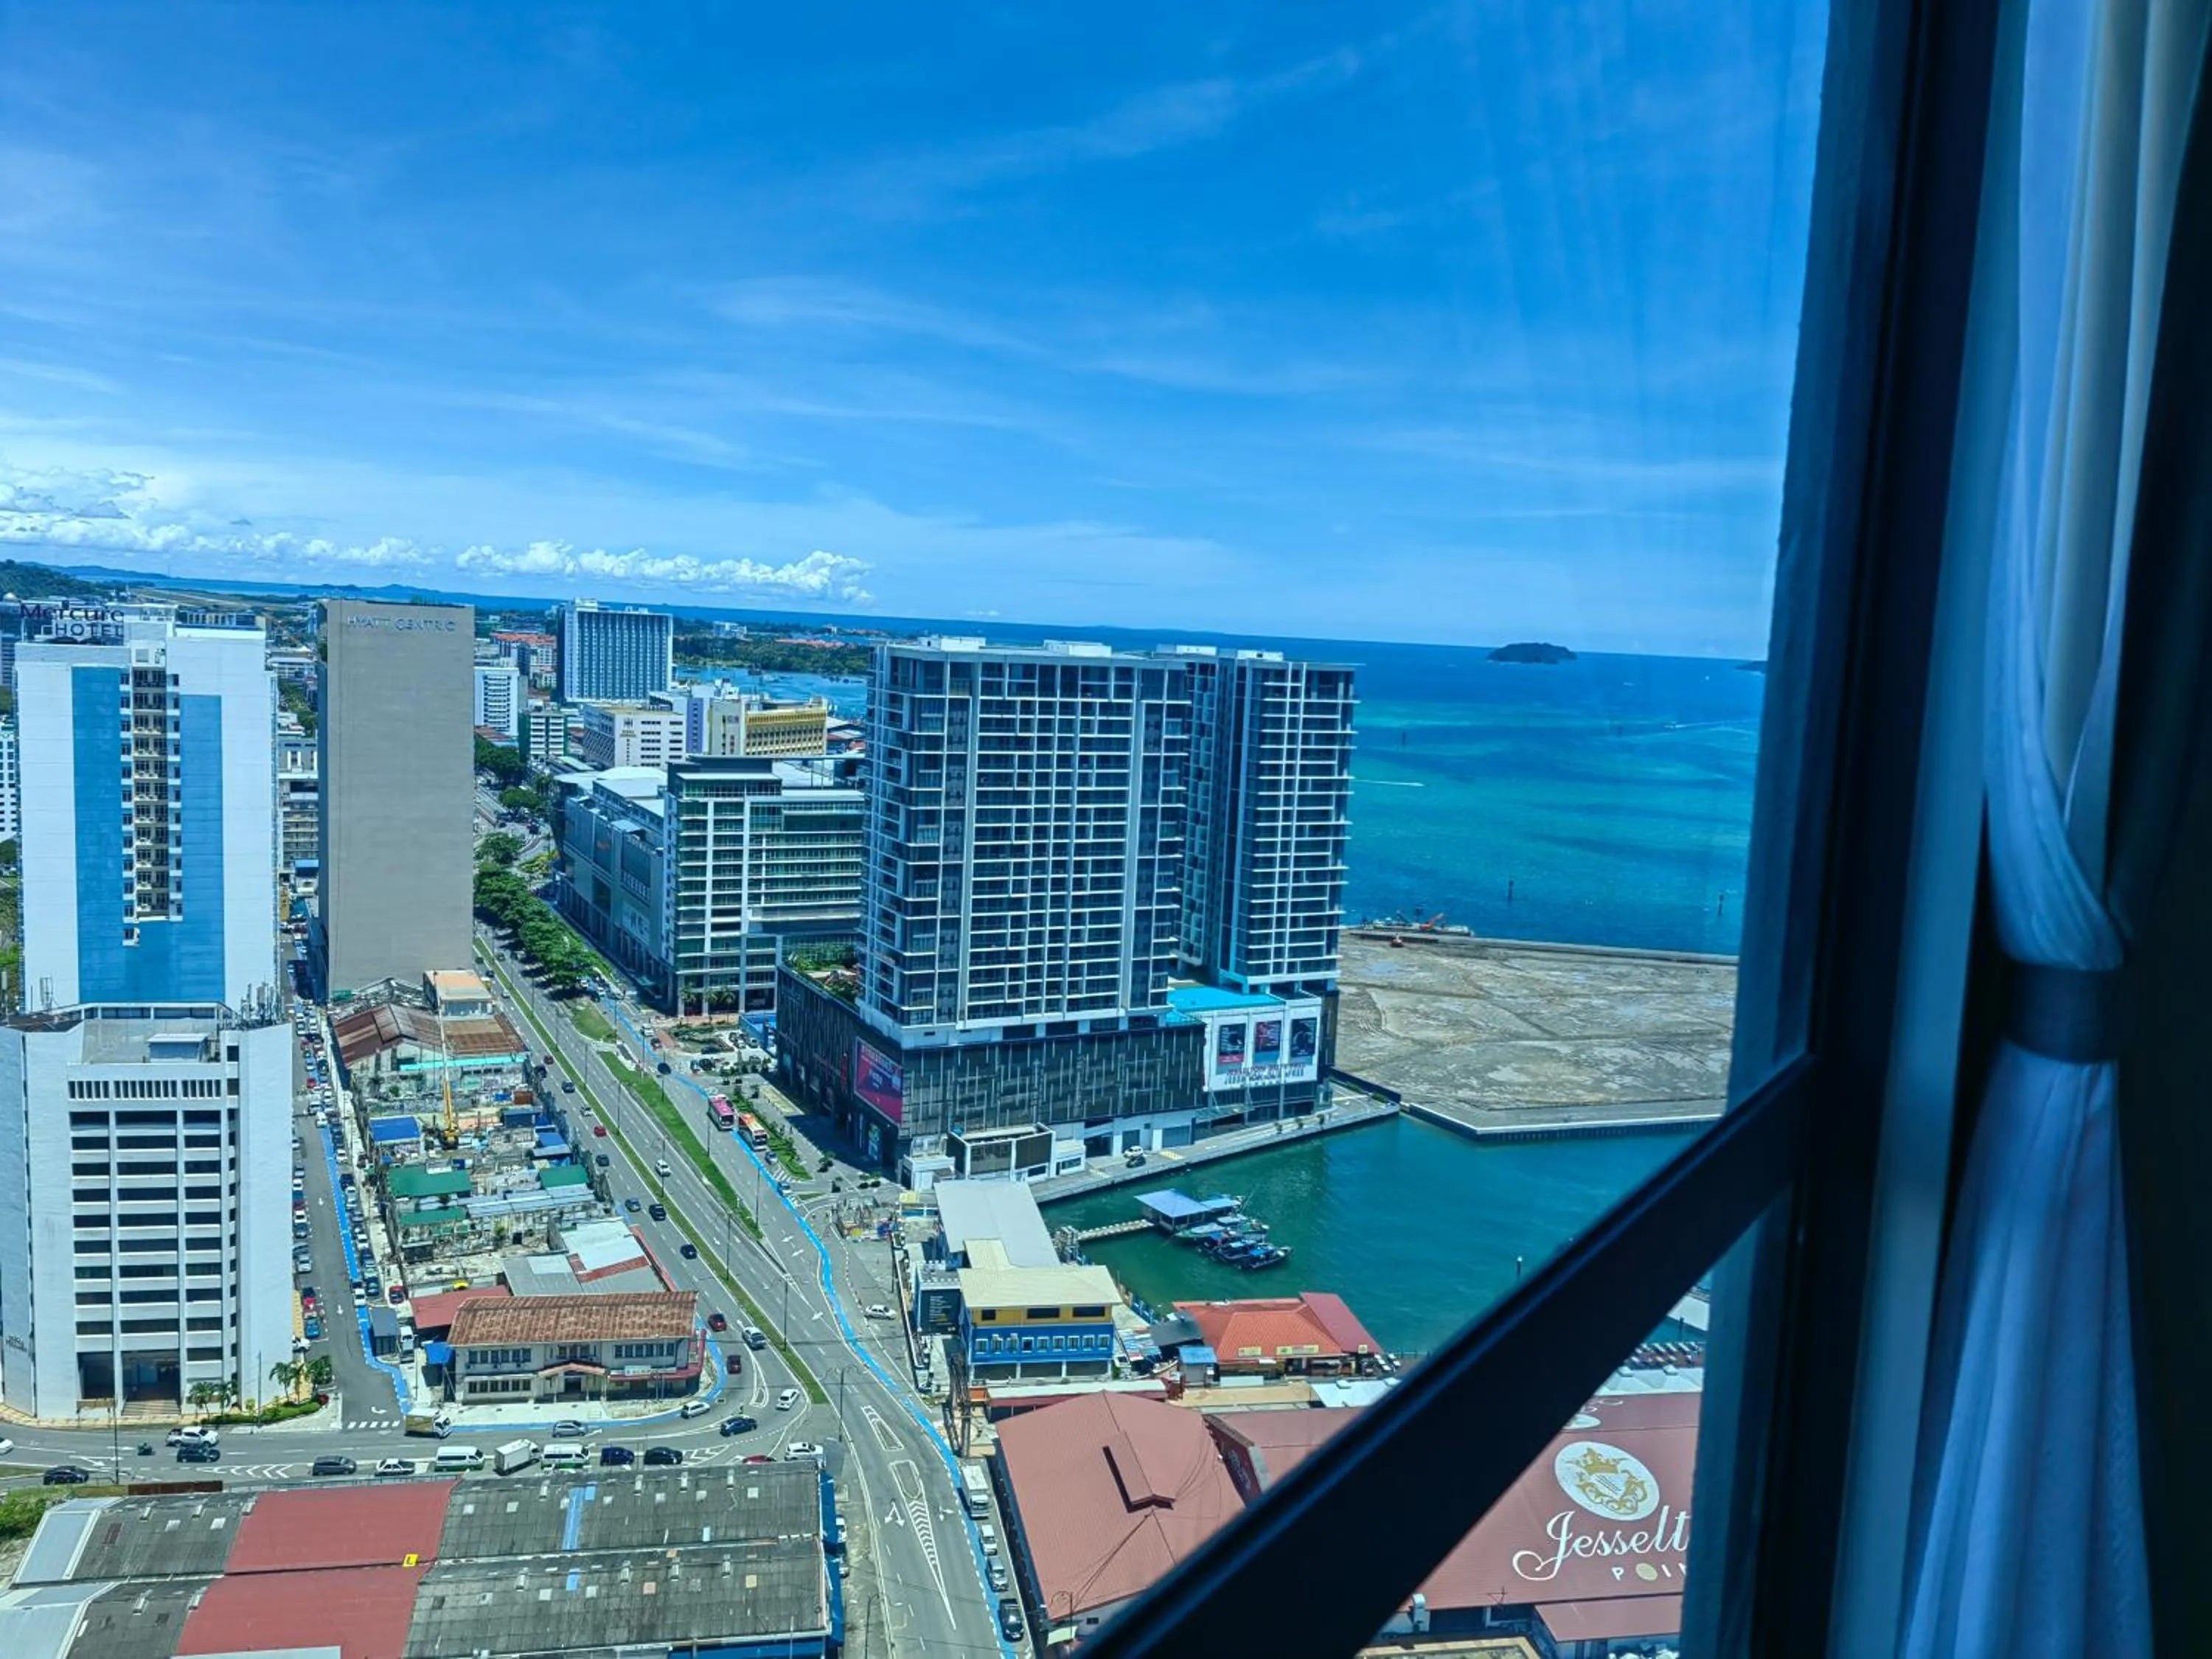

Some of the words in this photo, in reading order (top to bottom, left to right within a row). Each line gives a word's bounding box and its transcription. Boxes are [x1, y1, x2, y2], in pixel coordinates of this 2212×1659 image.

[20, 604, 124, 622] Mercure
[55, 622, 124, 638] HOTEL
[347, 616, 390, 628] HYATT
[394, 618, 456, 631] CENTRIC
[1512, 1505, 1691, 1581] Jesselt
